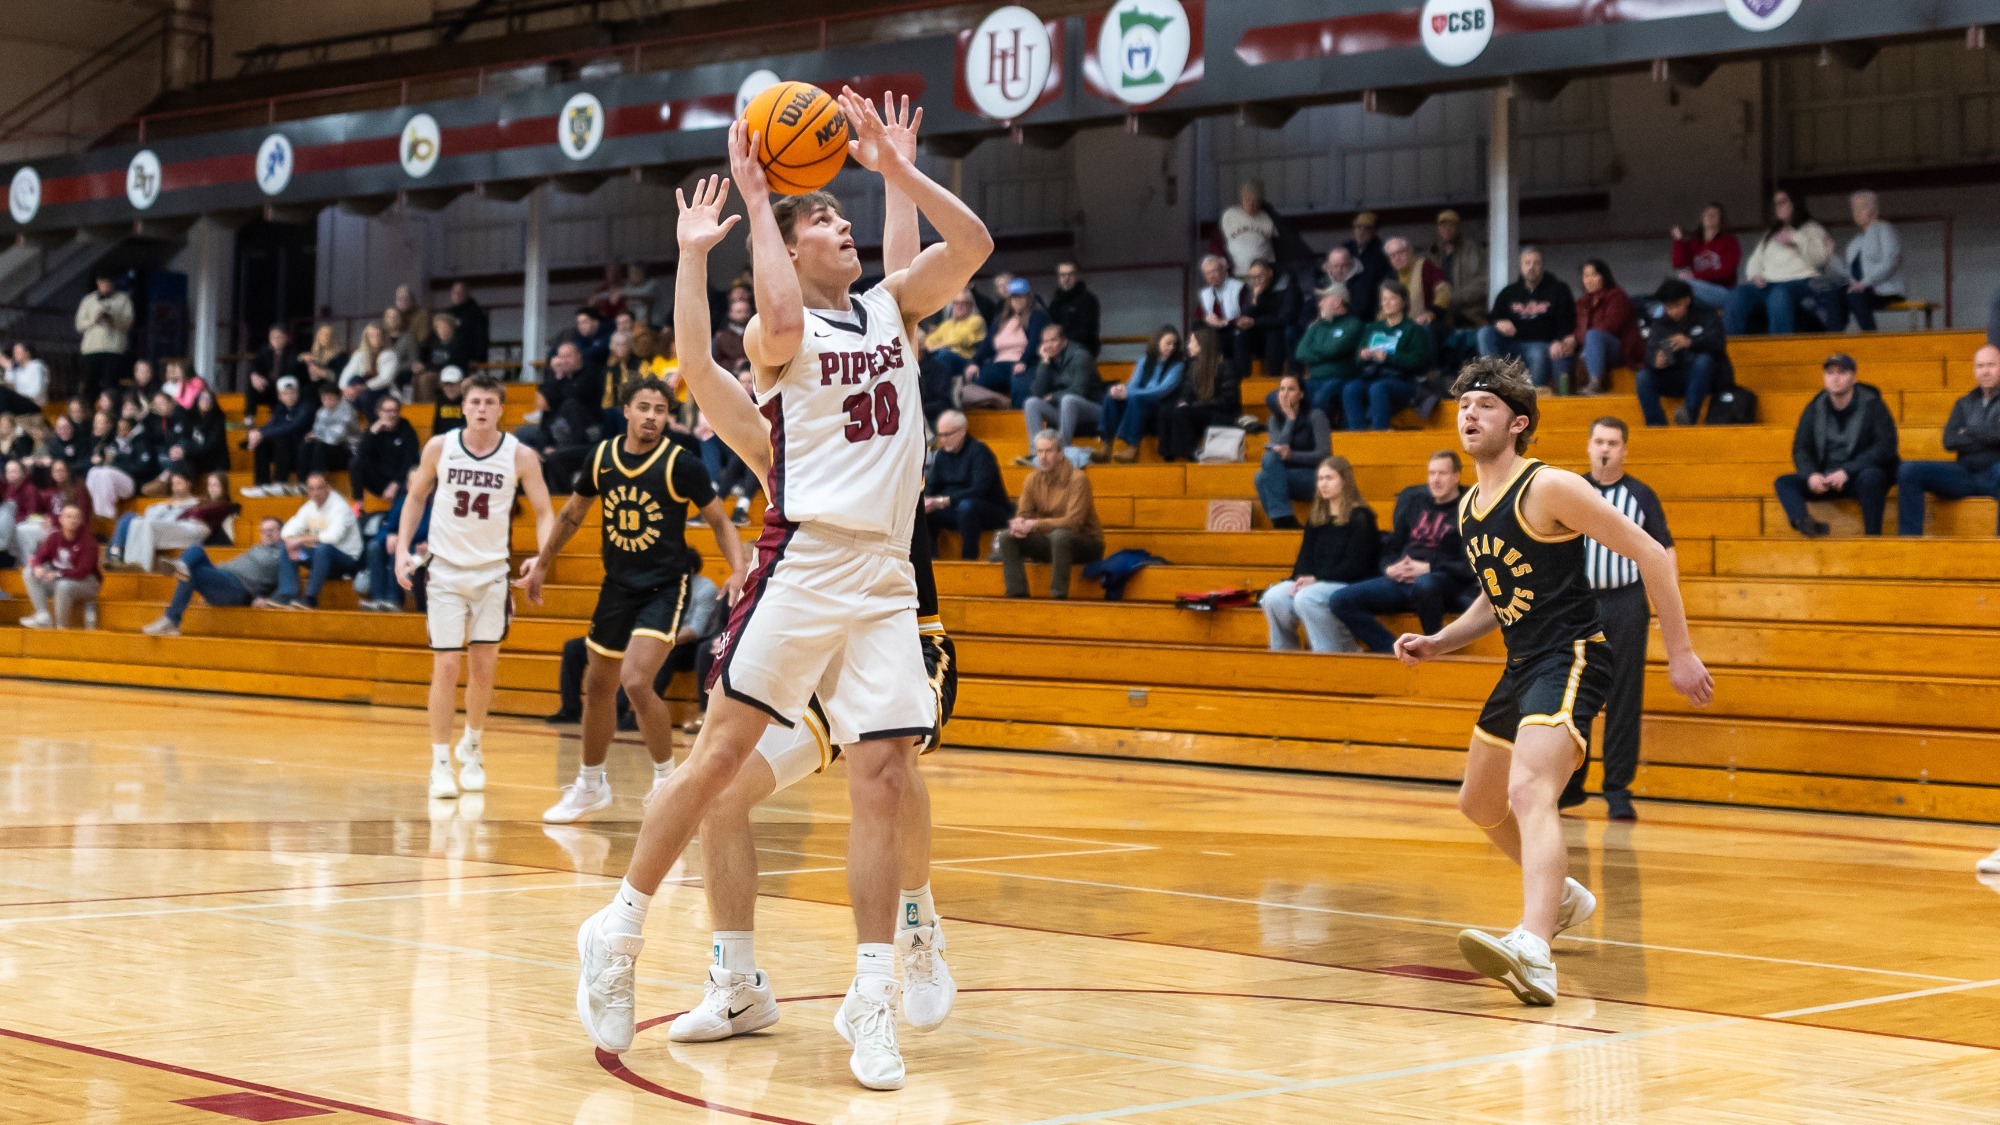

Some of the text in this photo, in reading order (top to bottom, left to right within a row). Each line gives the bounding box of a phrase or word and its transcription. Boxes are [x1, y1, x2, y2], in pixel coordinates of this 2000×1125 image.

[1448, 9, 1485, 33] CSB
[984, 27, 1037, 101] HU
[842, 380, 900, 443] 30
[447, 468, 504, 490] PIPERS
[453, 490, 490, 520] 34
[618, 509, 640, 531] 13
[1466, 534, 1533, 585] STAVUS
[1484, 567, 1503, 597] 2
